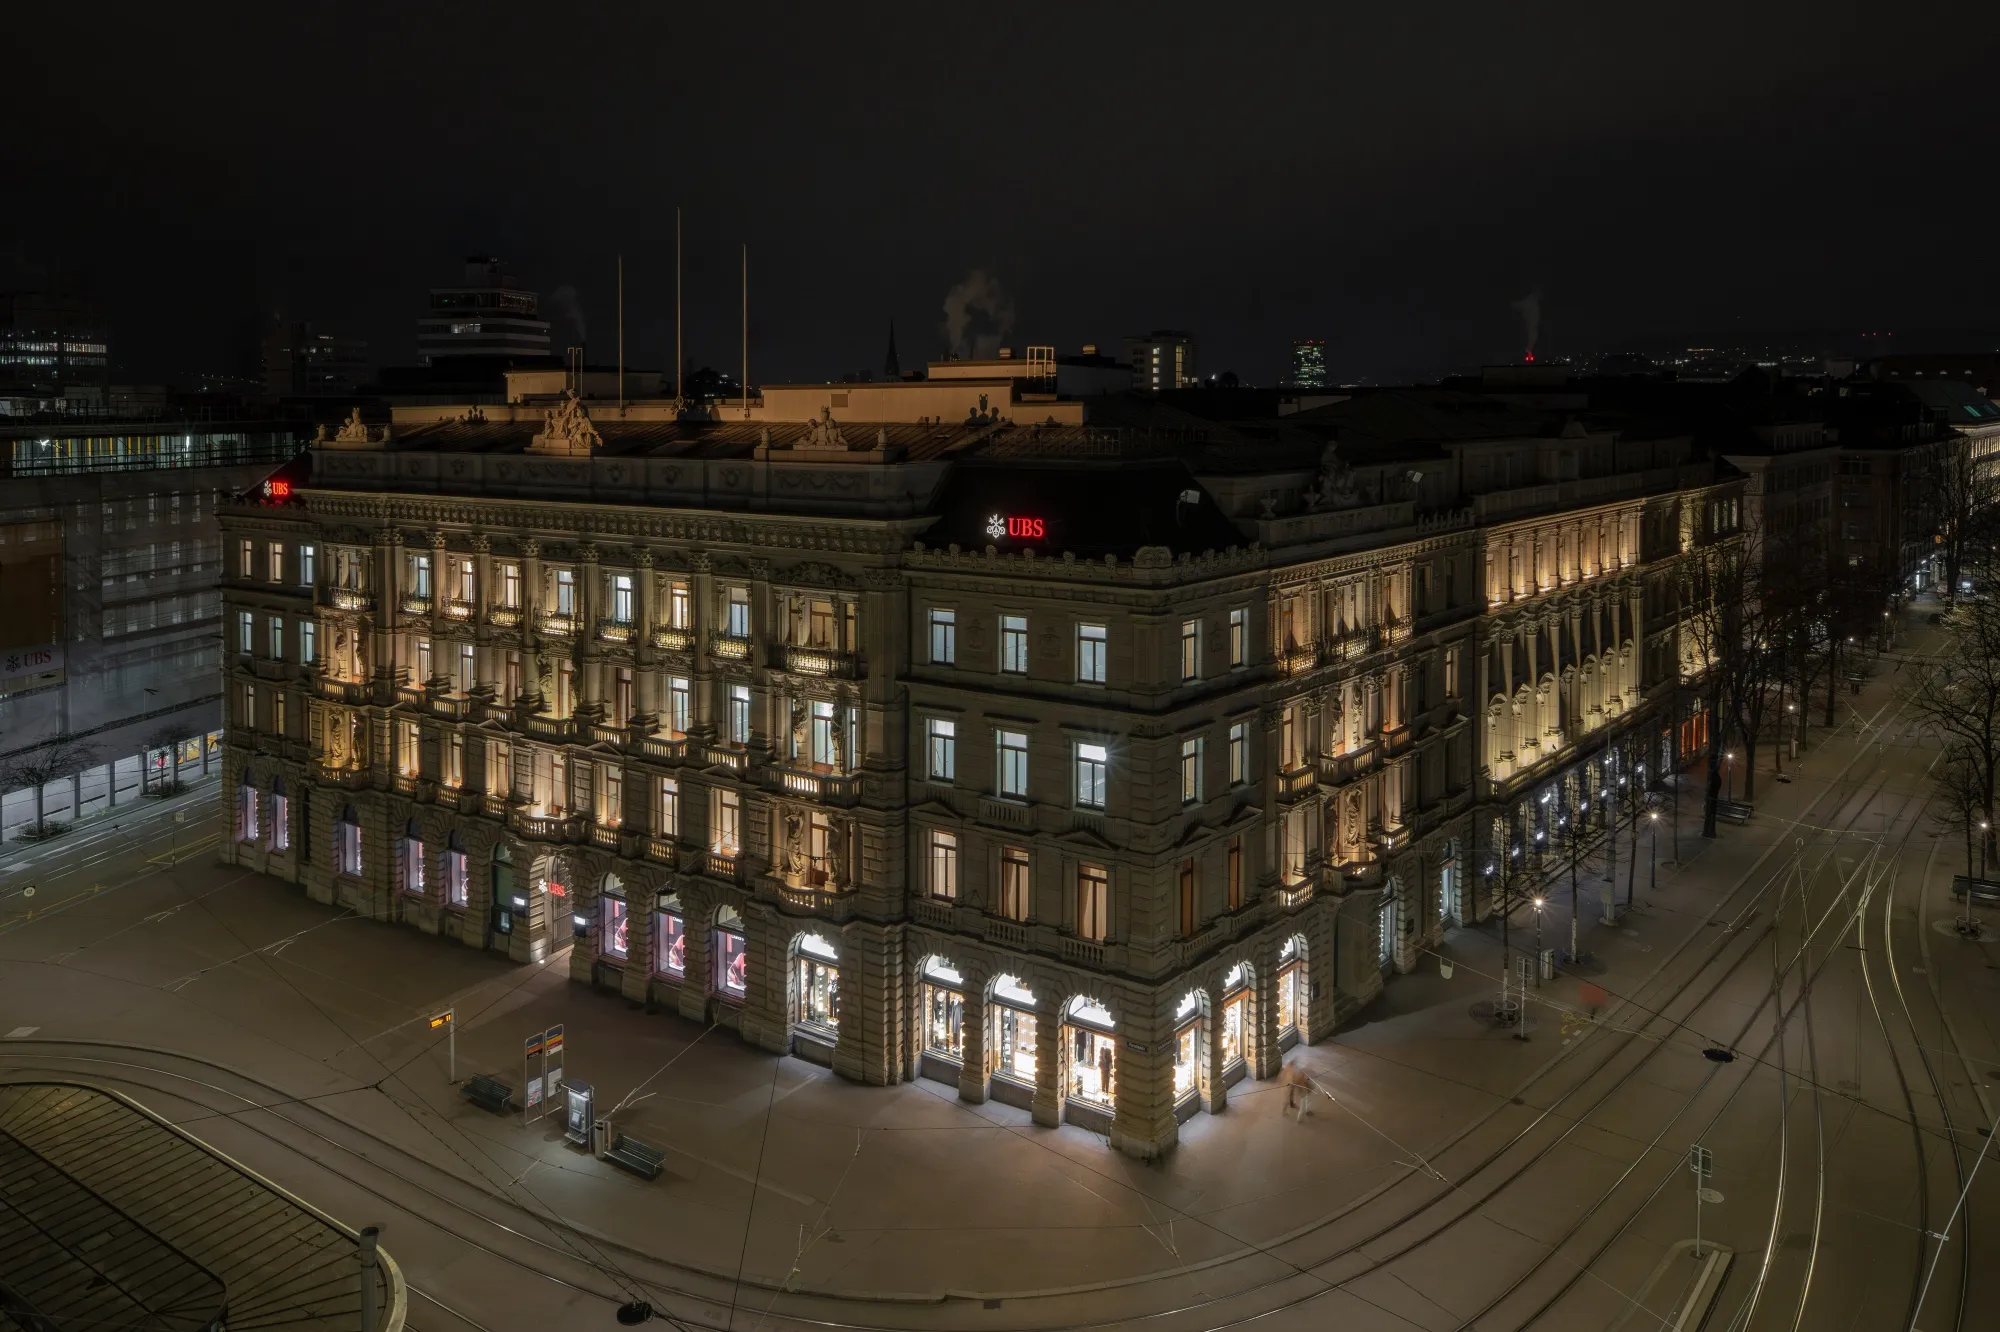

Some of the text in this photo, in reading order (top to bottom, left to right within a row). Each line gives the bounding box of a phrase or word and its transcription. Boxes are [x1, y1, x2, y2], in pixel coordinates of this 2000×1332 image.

[272, 482, 288, 495] UBS
[1008, 517, 1043, 537] UBS
[24, 650, 51, 667] UBS
[547, 882, 565, 897] UBS
